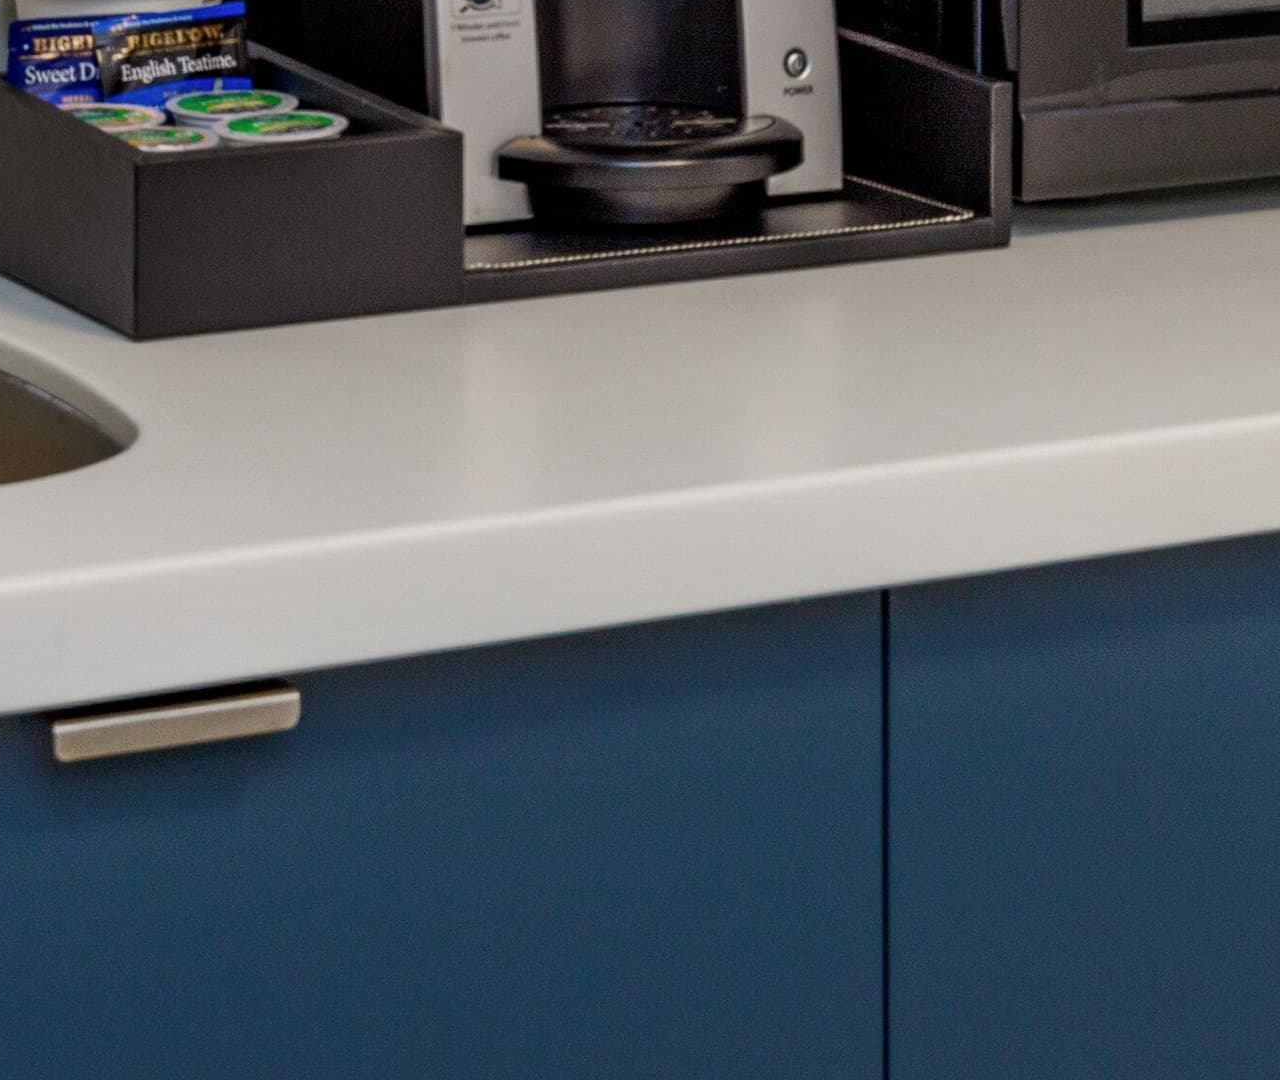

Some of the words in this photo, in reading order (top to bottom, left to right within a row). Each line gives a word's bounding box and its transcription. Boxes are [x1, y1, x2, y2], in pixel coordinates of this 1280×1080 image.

[126, 24, 224, 50] BIGELOW
[24, 64, 77, 85] Sweet
[121, 57, 176, 84] English
[783, 84, 814, 96] POWER
